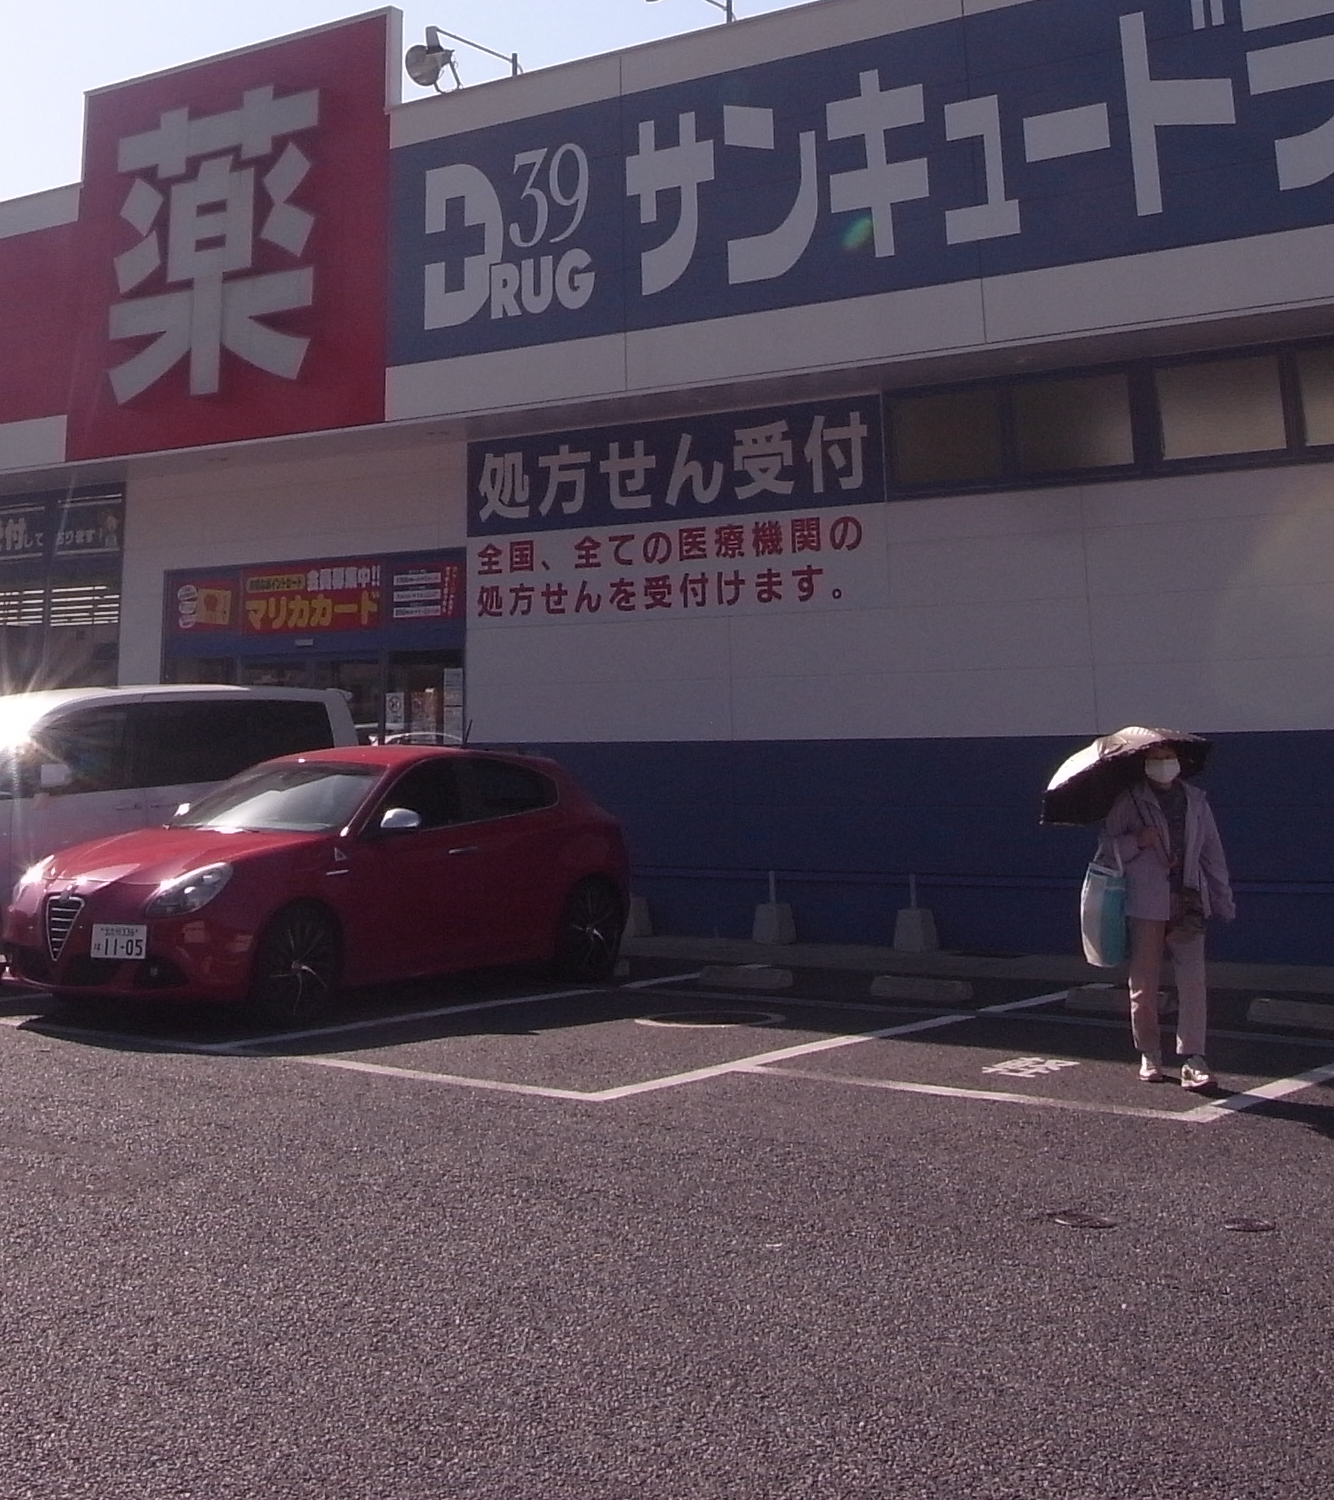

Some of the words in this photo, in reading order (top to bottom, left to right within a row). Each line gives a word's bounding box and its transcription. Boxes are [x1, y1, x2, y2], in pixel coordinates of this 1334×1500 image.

[509, 142, 590, 249] 39
[108, 84, 320, 405] 薬
[477, 411, 869, 523] 処方せん受付
[477, 516, 863, 577] 全国、全ての医療機関の
[245, 590, 379, 630] マリカカード
[477, 564, 845, 619] 処方せんを受付けます。
[104, 938, 144, 956] 11-05
